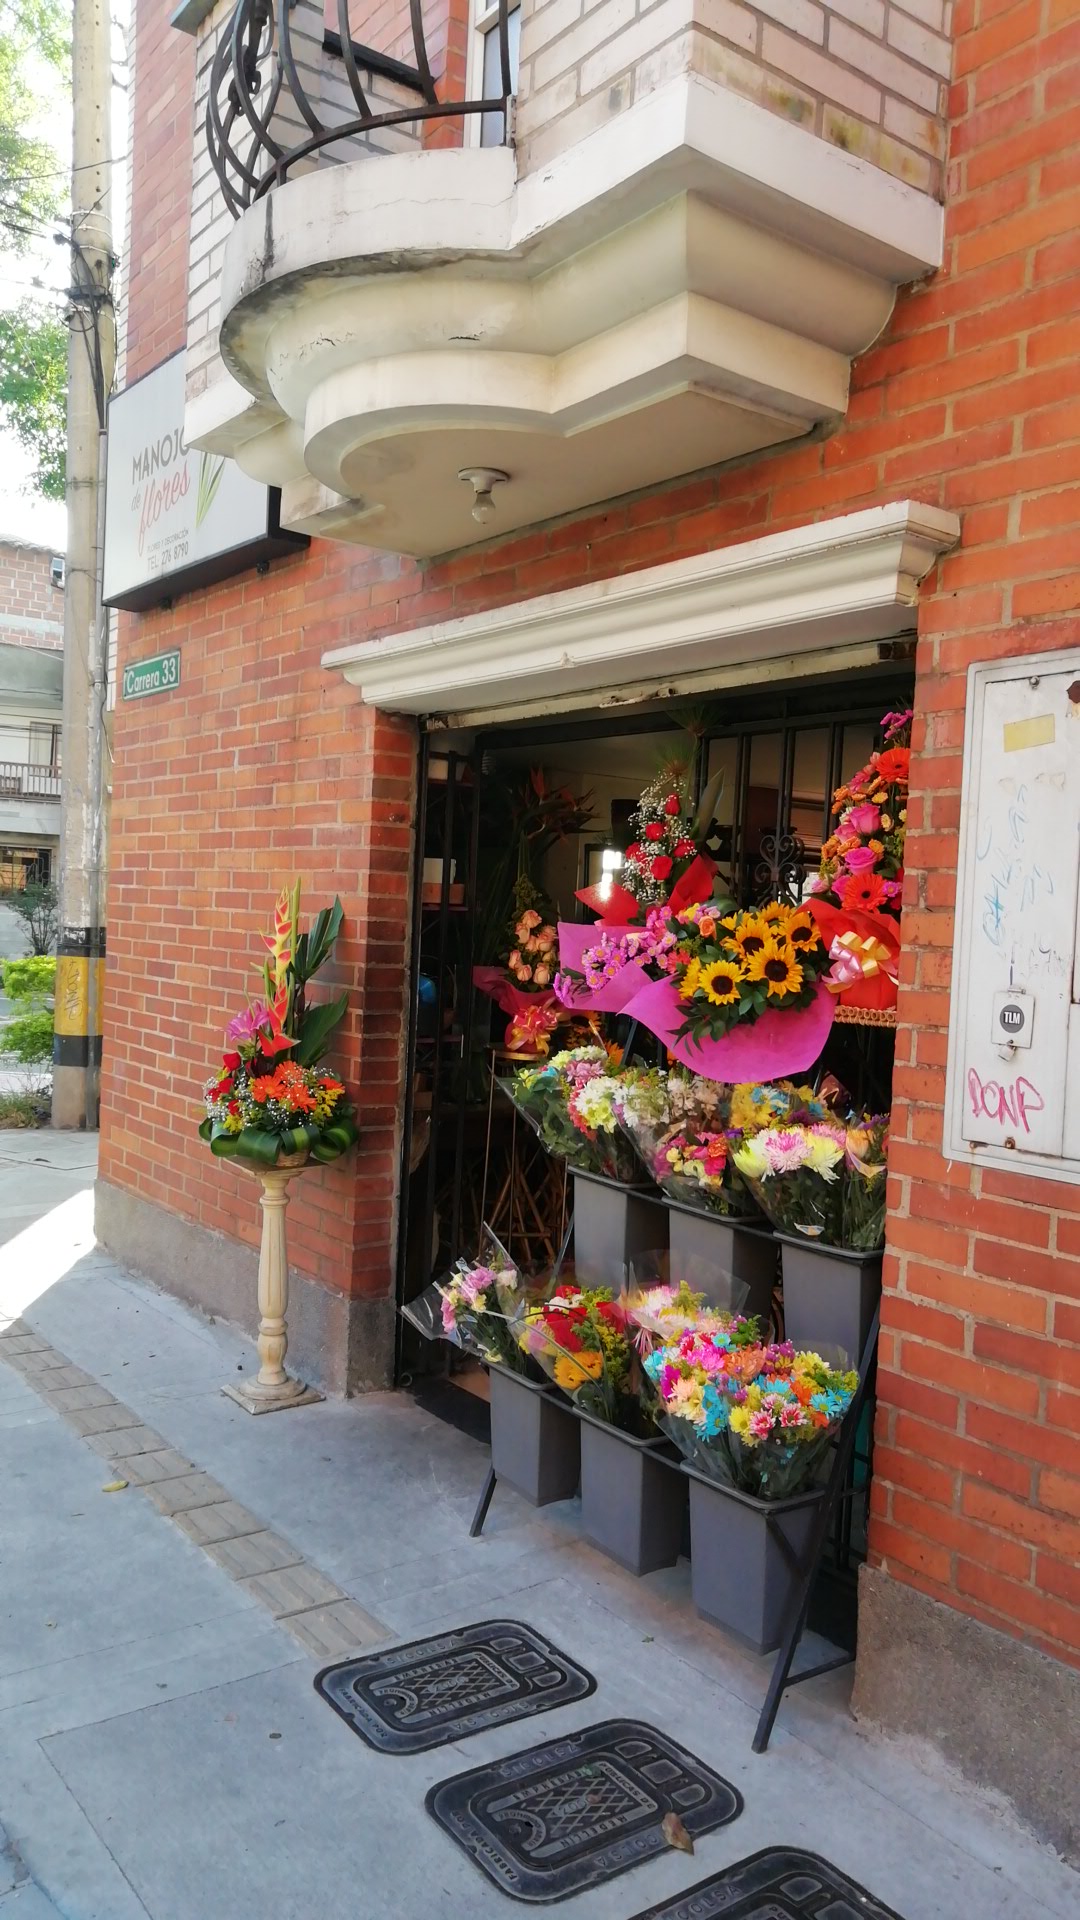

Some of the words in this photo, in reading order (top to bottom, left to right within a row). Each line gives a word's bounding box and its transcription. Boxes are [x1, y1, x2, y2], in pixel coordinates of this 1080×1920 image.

[138, 459, 191, 557] flores
[161, 548, 171, 565] 276
[174, 541, 188, 560] 8790
[127, 670, 160, 693] Carrera
[162, 657, 176, 684] 33
[1003, 1011, 1020, 1024] TLM
[560, 1814, 629, 1848] MEDELLIN
